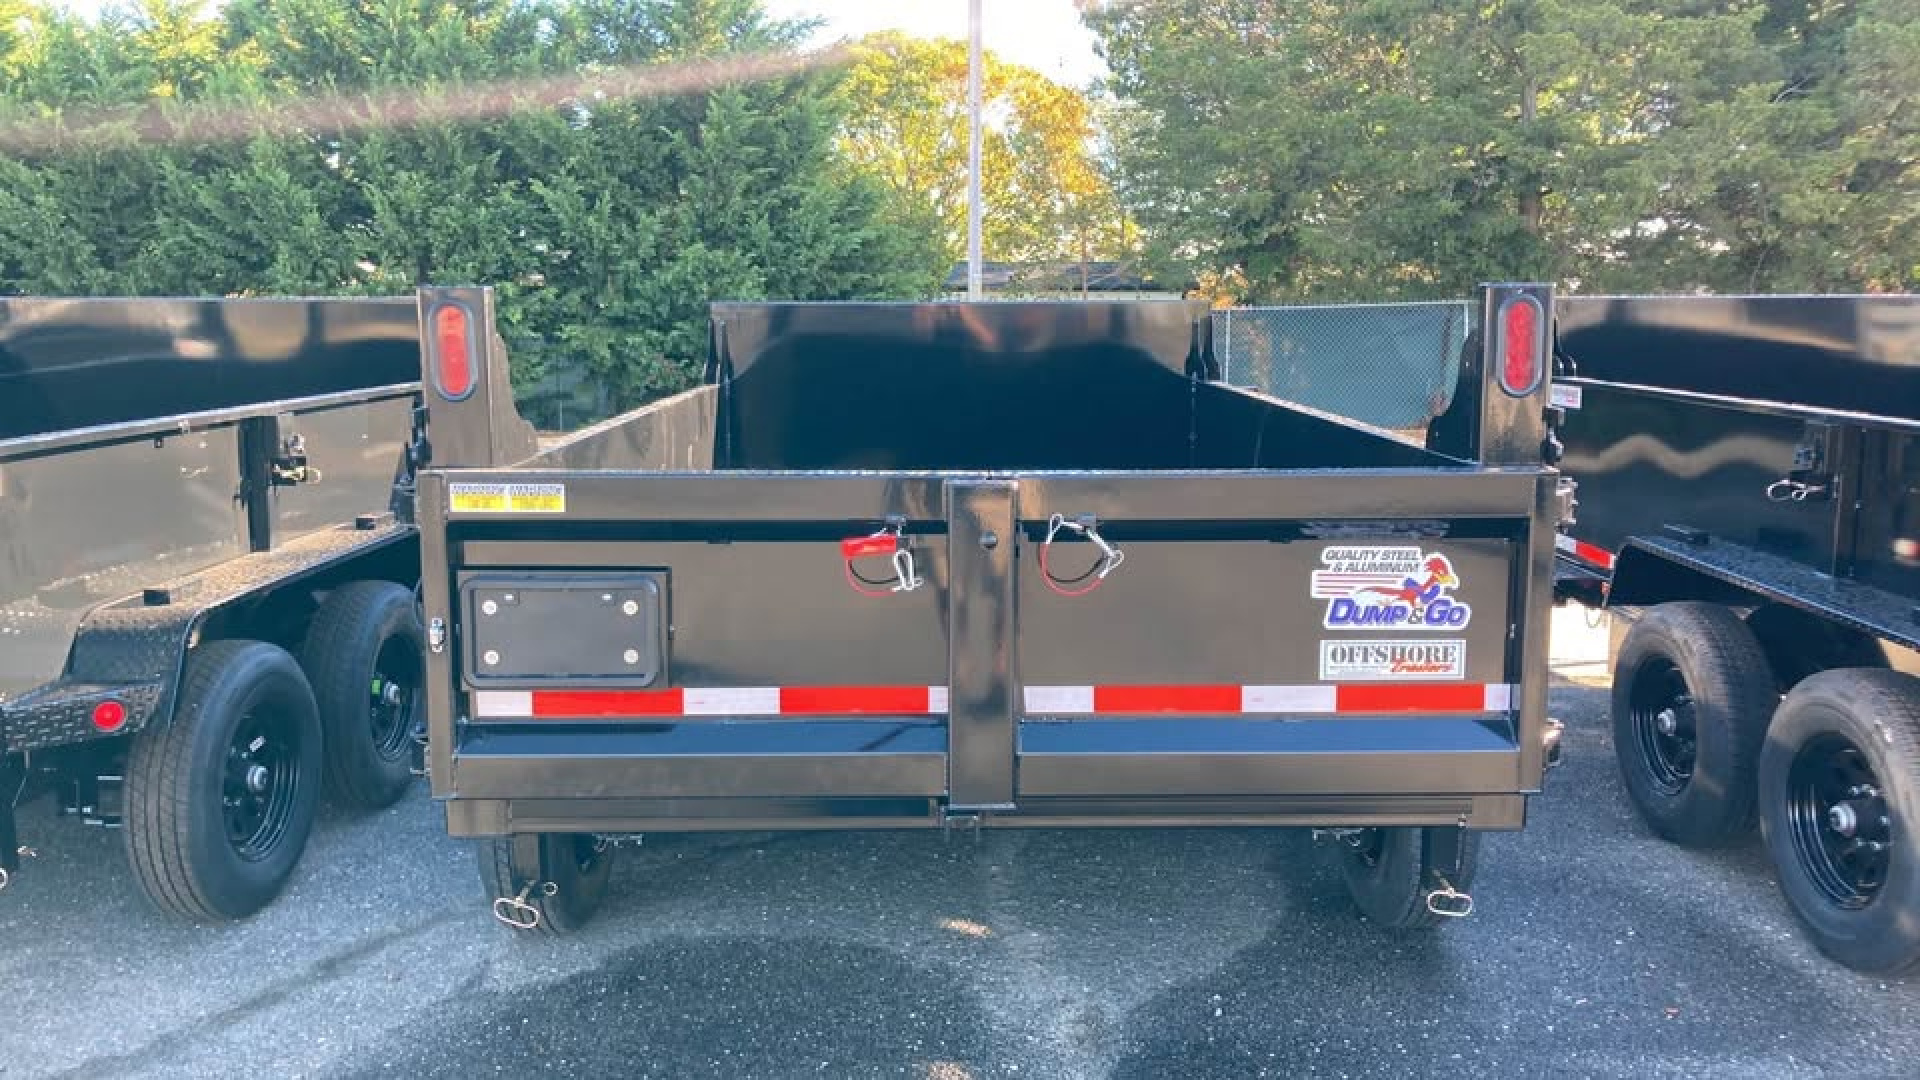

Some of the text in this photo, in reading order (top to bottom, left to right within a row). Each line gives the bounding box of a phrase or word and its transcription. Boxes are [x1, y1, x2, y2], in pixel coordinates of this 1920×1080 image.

[1325, 549, 1418, 561] QUALITY STEEL
[1330, 645, 1457, 663] OFFSHORE
